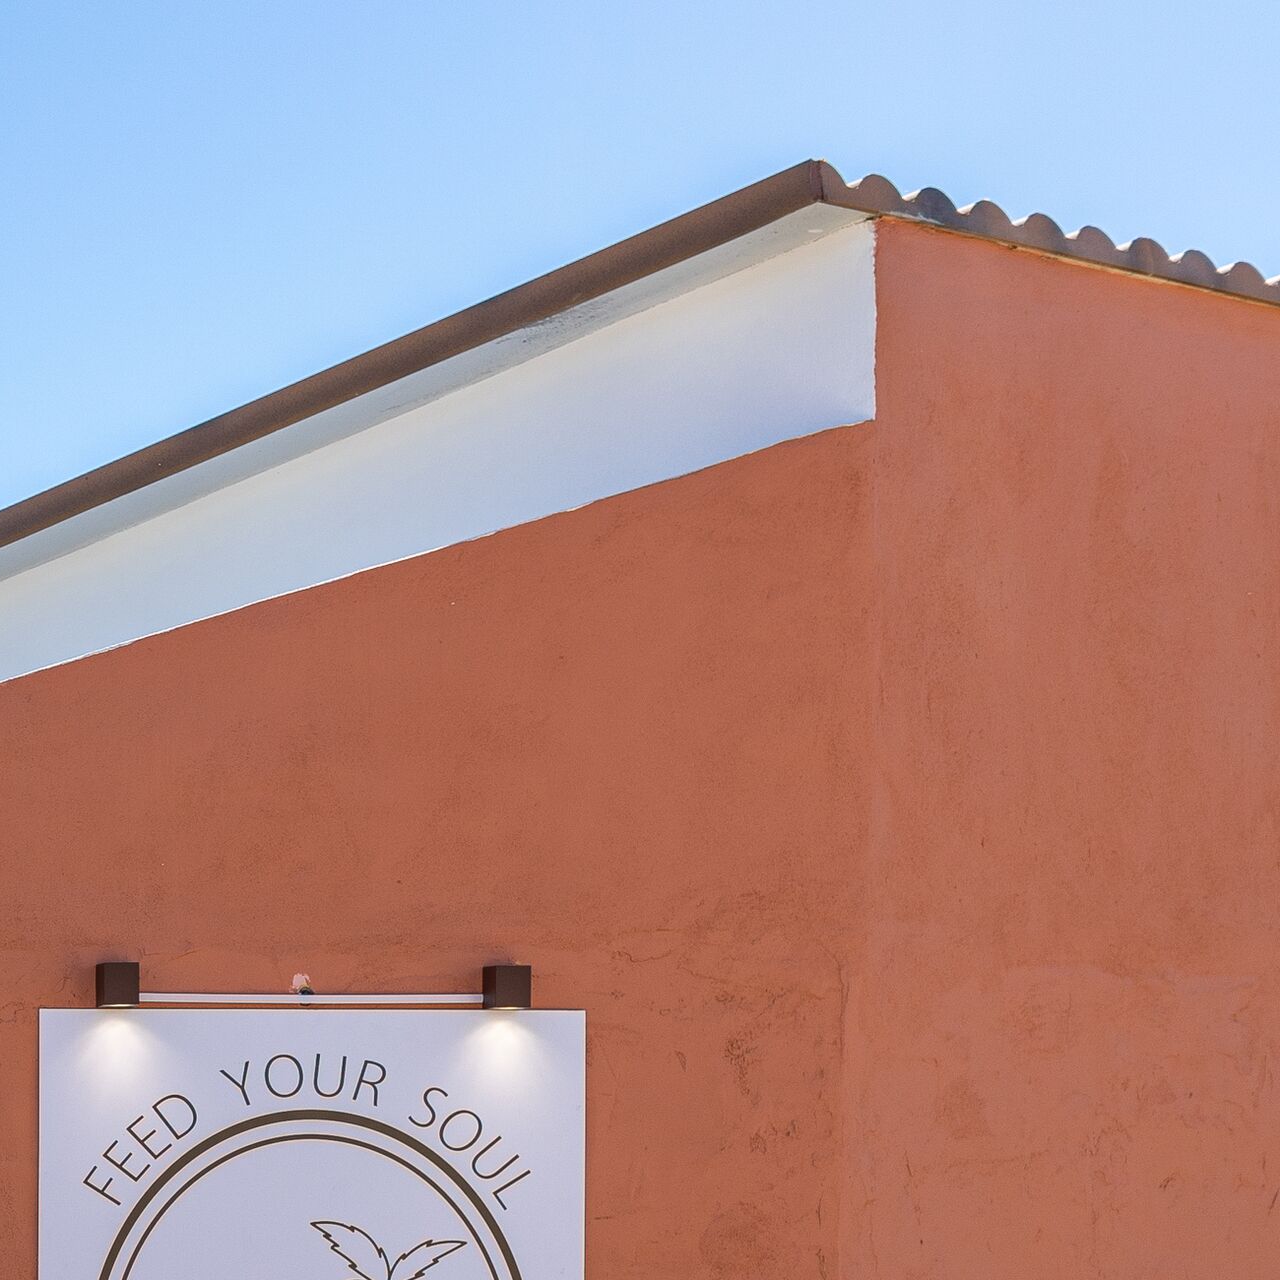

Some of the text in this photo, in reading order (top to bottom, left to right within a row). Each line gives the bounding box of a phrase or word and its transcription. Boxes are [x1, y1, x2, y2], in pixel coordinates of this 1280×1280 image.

[83, 1053, 531, 1211] FEED YOUR SOUL
